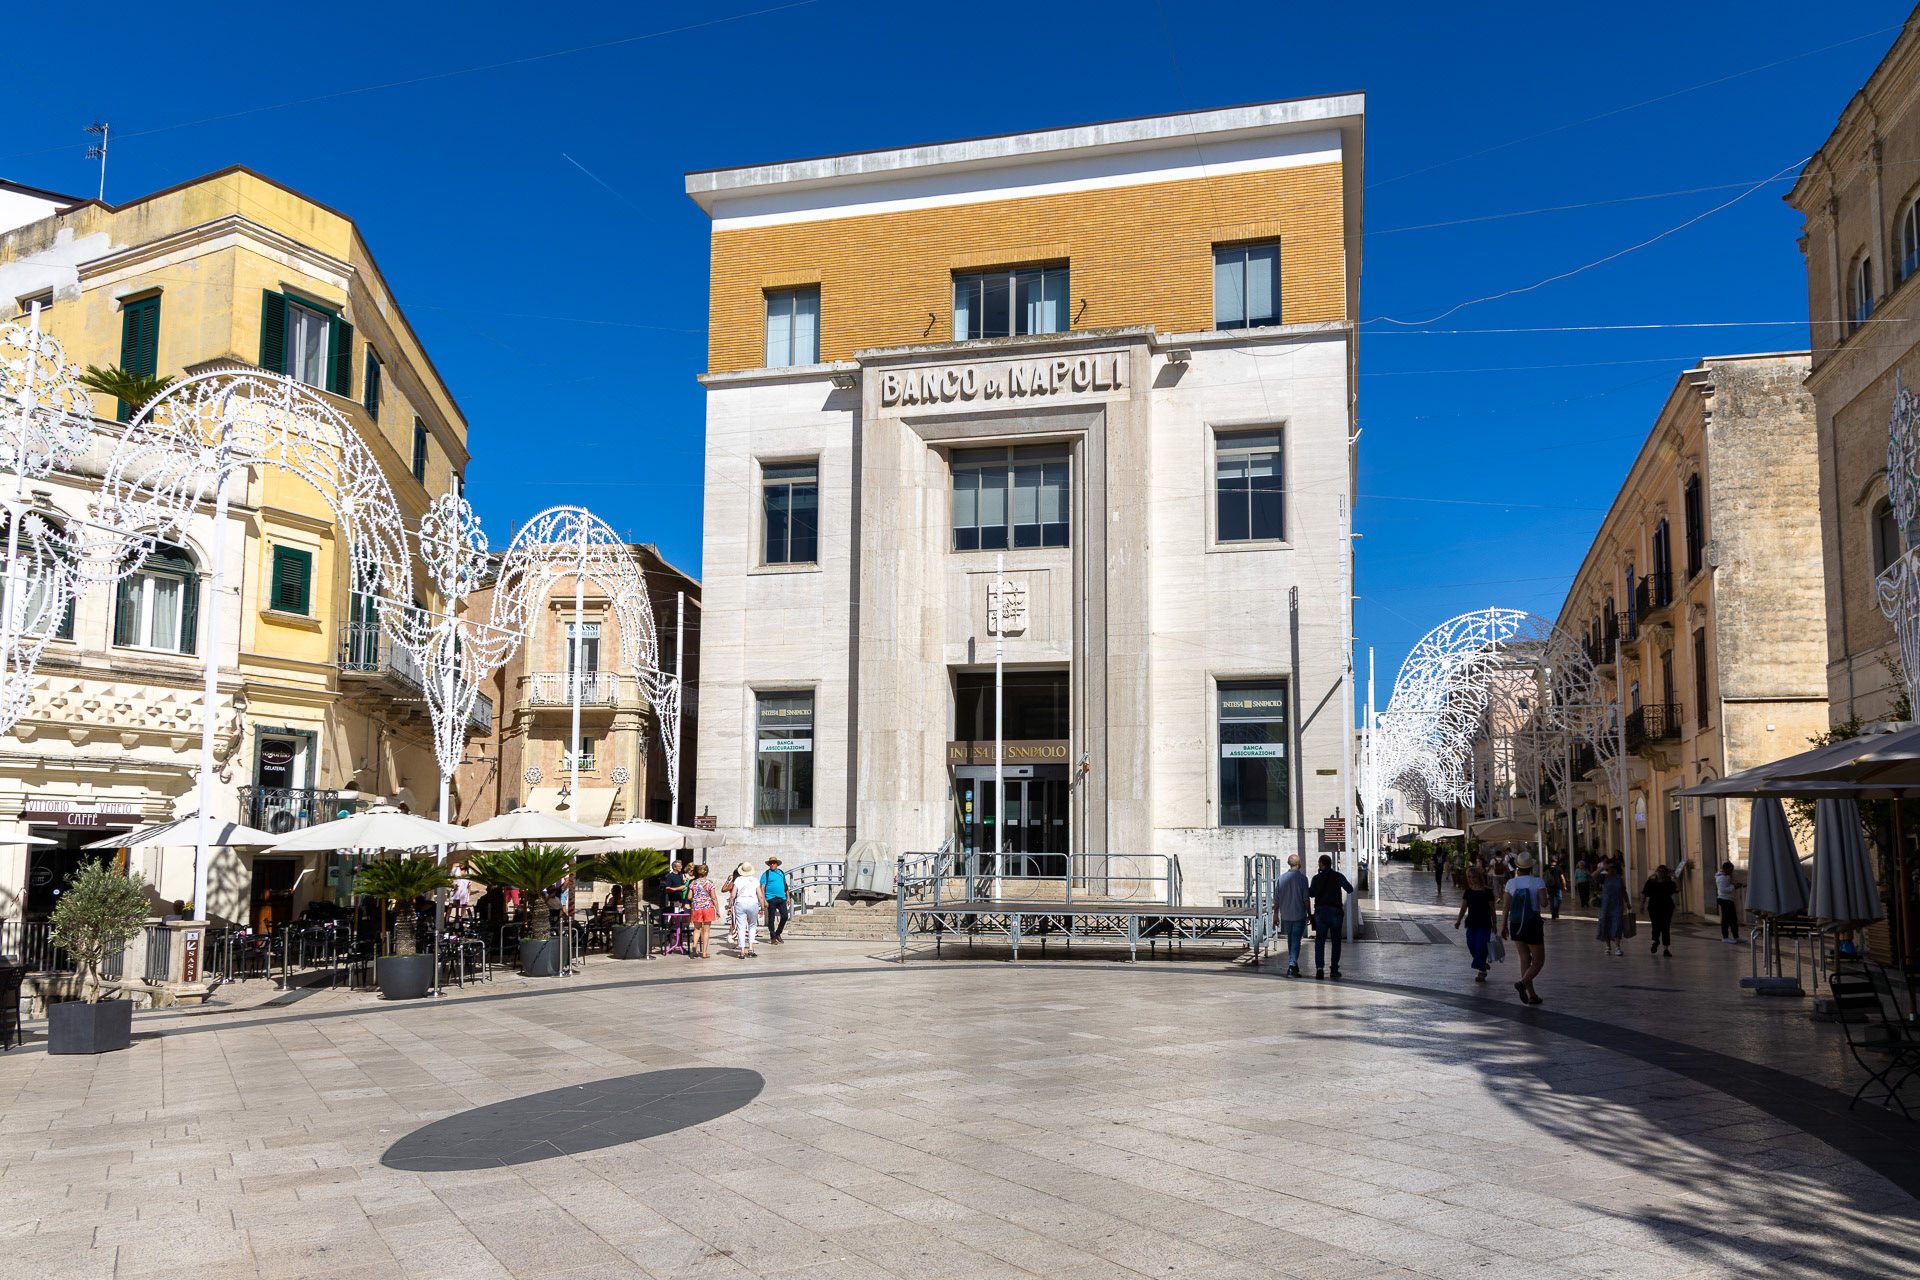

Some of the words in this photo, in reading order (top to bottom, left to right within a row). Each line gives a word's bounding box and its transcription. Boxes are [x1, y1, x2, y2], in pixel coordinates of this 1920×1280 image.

[882, 364, 978, 405] BANCO
[1009, 353, 1122, 396] NAPOLI
[950, 747, 988, 759] INTESA
[1008, 745, 1067, 758] SANPAOLO
[28, 800, 70, 813] VITTORIO
[99, 803, 132, 815] VENETO
[187, 950, 195, 982] SASSI
